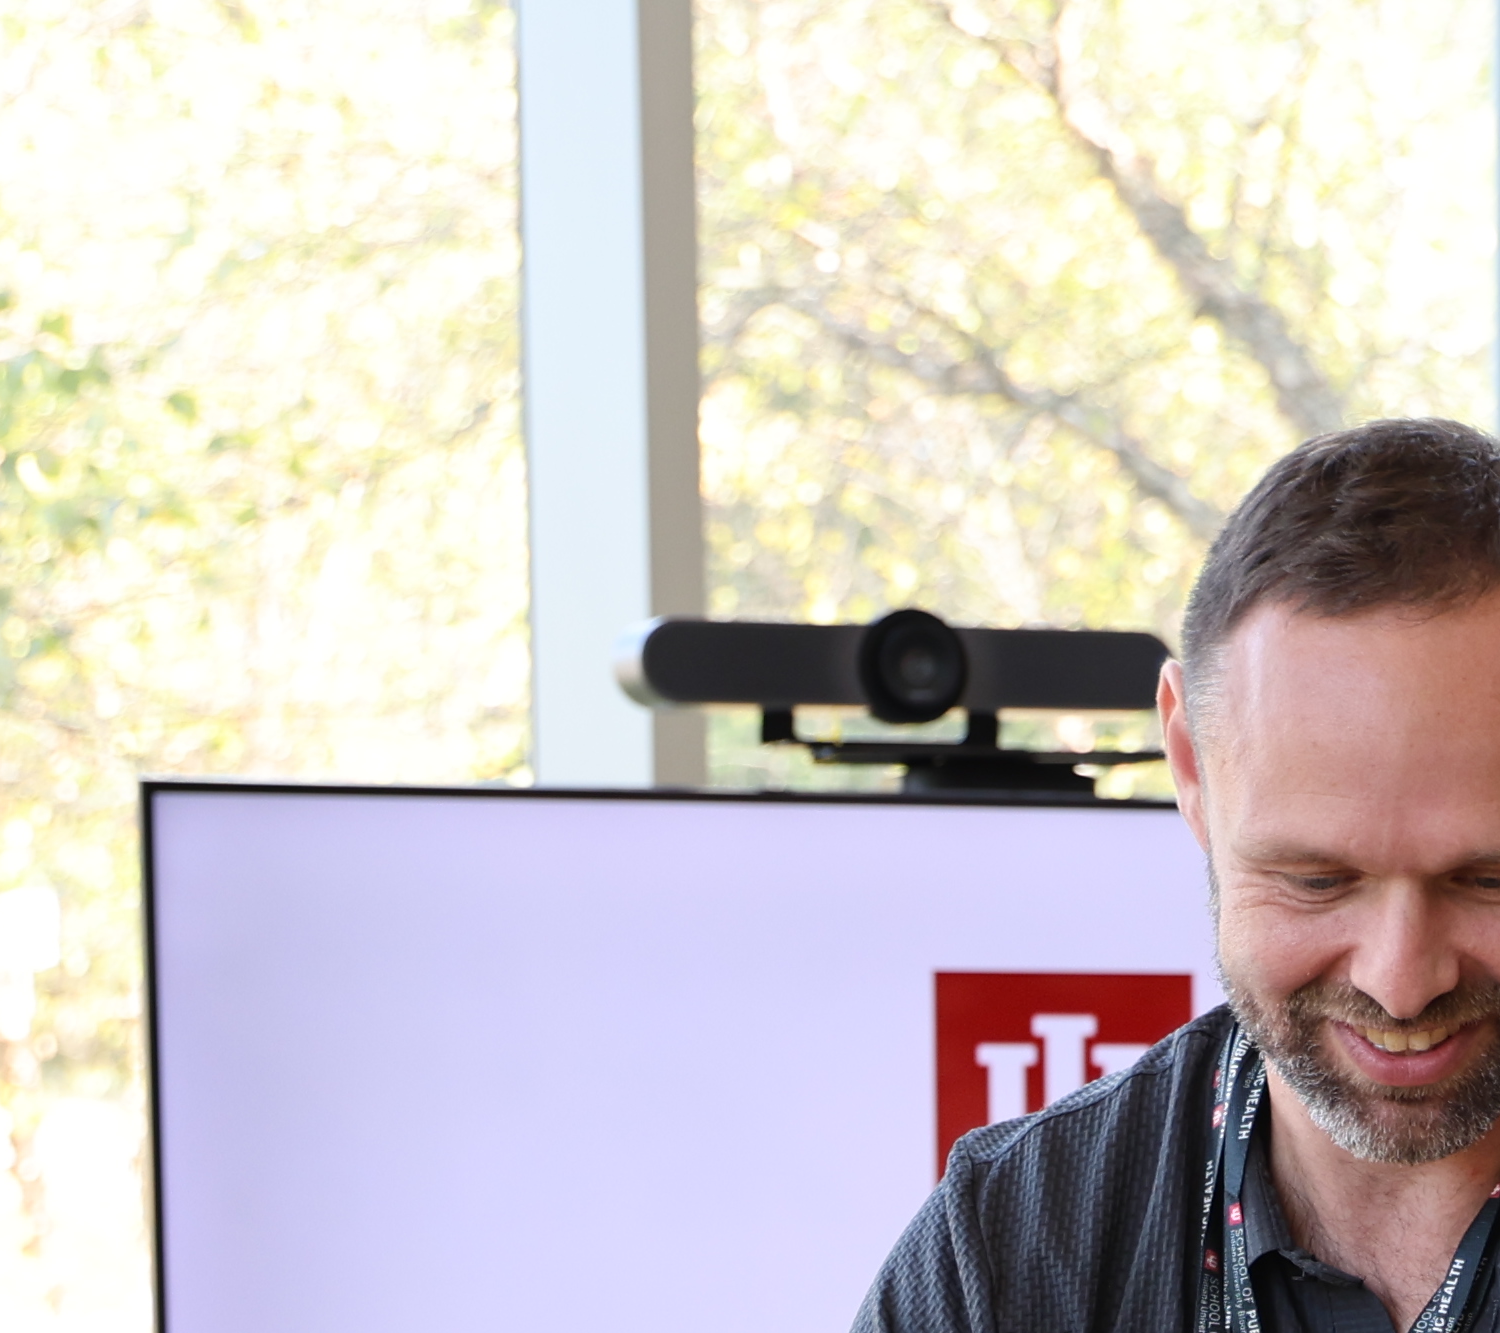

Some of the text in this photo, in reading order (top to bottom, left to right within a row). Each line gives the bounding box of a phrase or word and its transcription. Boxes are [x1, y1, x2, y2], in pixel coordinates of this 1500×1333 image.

[1238, 1088, 1263, 1140] HEALTH
[1202, 1159, 1214, 1213] HEALTH
[1232, 1264, 1243, 1309] University
[1235, 1228, 1249, 1284] SCHOOL
[1242, 1287, 1255, 1303] OF
[1438, 1258, 1465, 1314] HEALTH
[1208, 1276, 1220, 1328] SCHOOL
